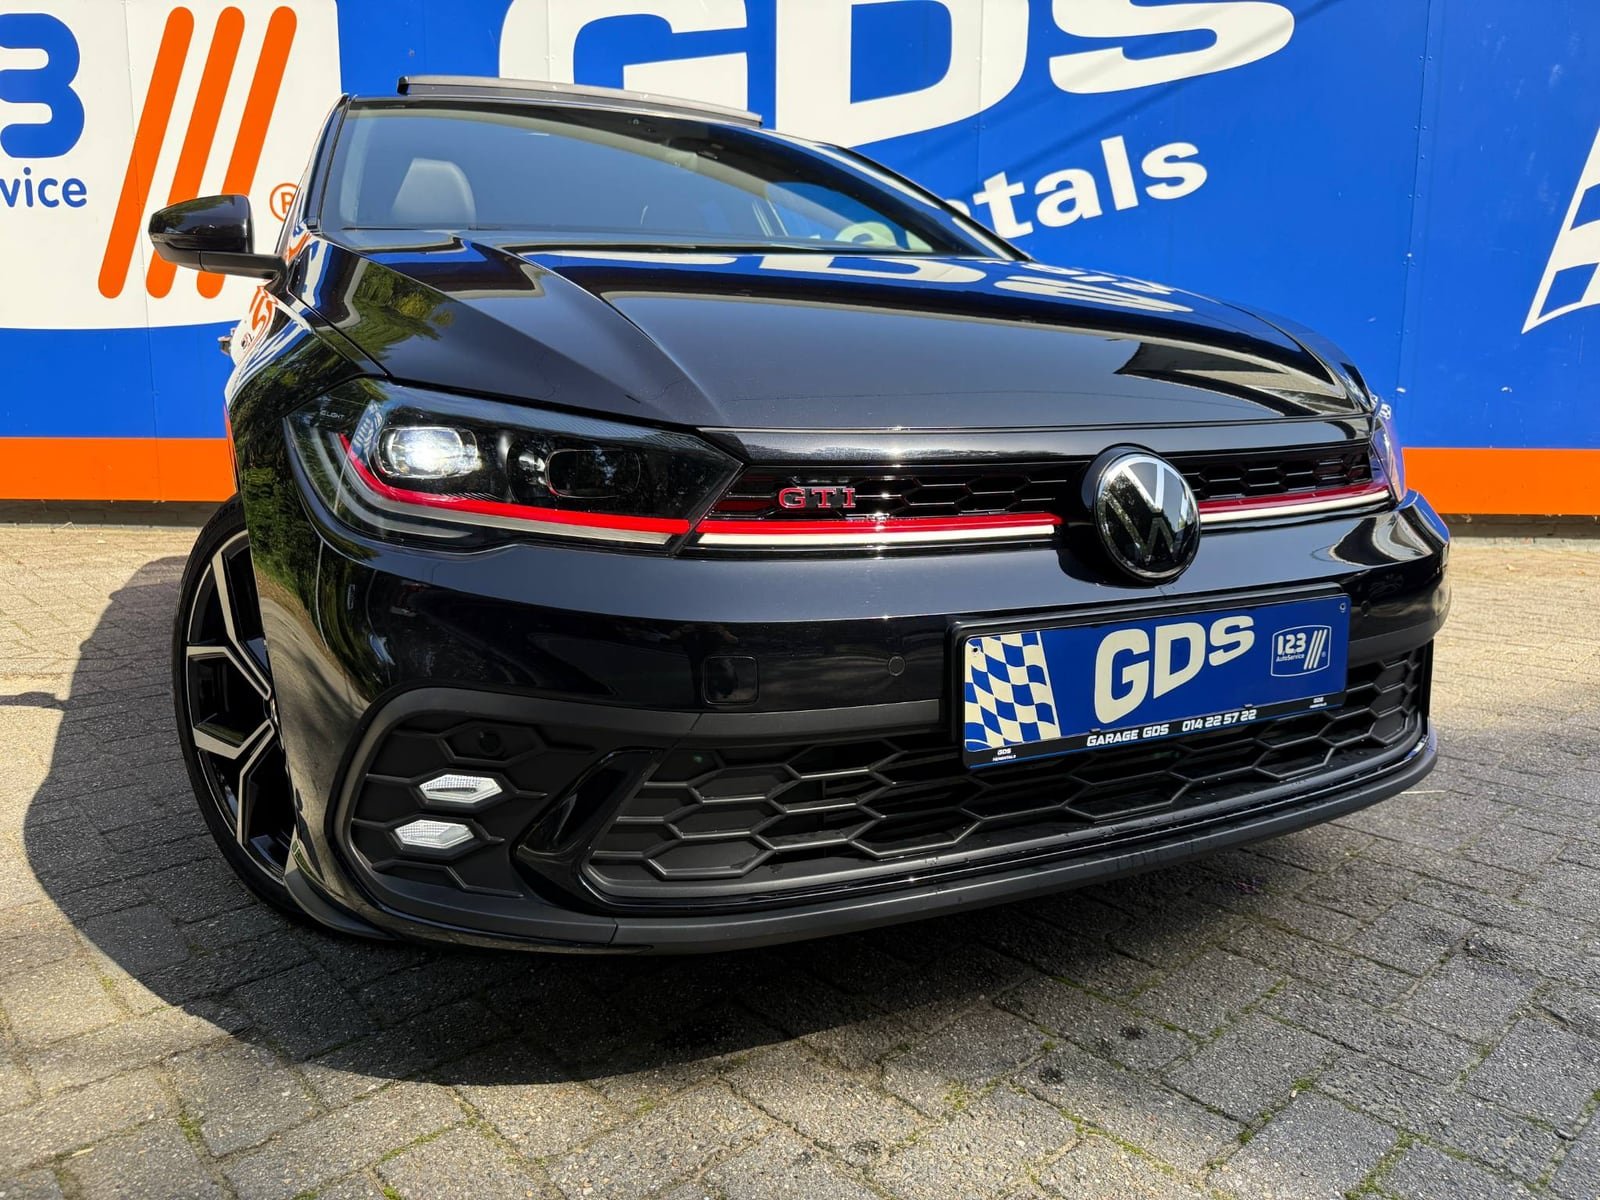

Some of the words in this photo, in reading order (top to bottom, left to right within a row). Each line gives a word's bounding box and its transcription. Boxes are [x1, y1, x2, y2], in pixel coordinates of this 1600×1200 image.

[943, 134, 1208, 239] tals
[778, 486, 856, 509] GTI
[1094, 614, 1256, 725] GDS
[1086, 729, 1139, 747] GARAGE
[1142, 723, 1170, 739] GDS
[1182, 718, 1204, 732] 014
[1205, 714, 1222, 728] 22
[1223, 711, 1240, 725] 57
[1240, 709, 1257, 722] 22
